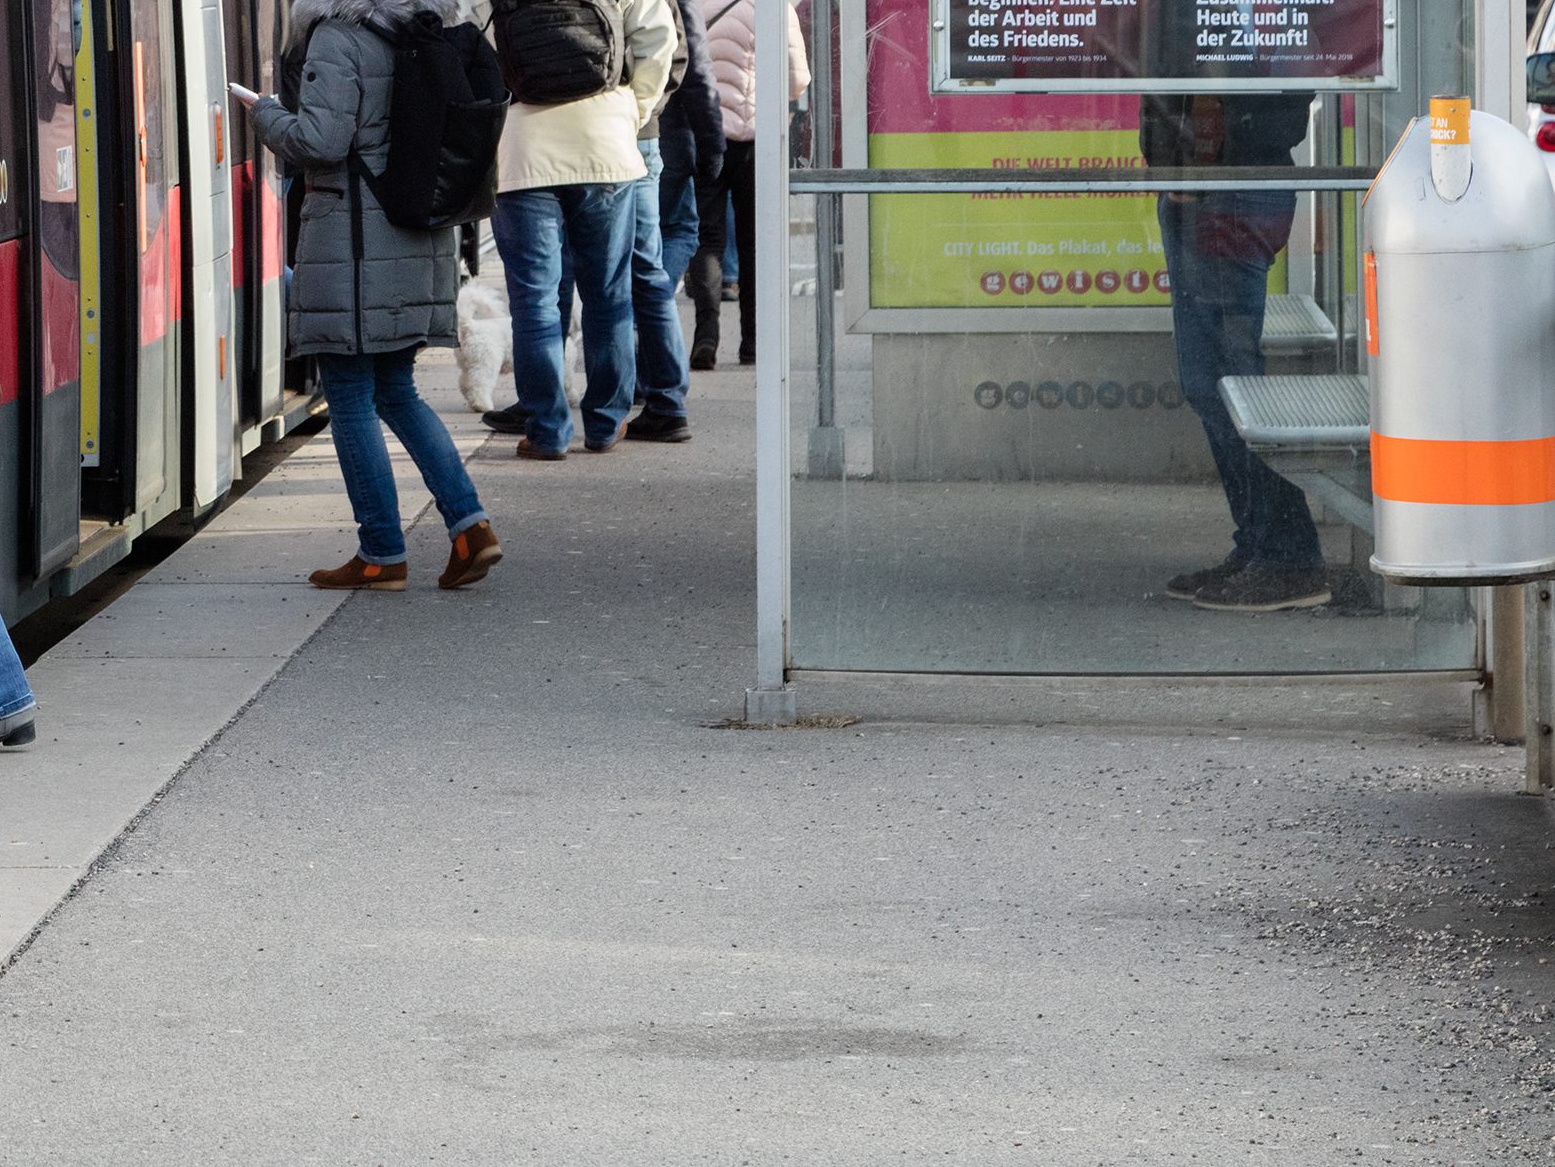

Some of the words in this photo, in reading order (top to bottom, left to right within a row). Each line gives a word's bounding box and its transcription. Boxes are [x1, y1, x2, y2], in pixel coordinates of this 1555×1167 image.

[968, 10, 998, 27] der
[1002, 9, 1059, 27] Arbeit
[1064, 9, 1097, 27] und
[1196, 9, 1249, 26] Heute
[1255, 8, 1287, 25] und
[1292, 8, 1309, 25] in
[968, 30, 999, 47] des
[1004, 30, 1084, 47] Friedens.
[1196, 30, 1227, 47] der
[1231, 29, 1308, 47] Zukunft!
[1012, 55, 1054, 64] Bürgermeister
[1260, 54, 1302, 63] Bürgermeister
[943, 242, 974, 256] CITY
[1028, 241, 1054, 255] Das
[1059, 239, 1111, 256] Plakat,
[1116, 239, 1142, 254] das
